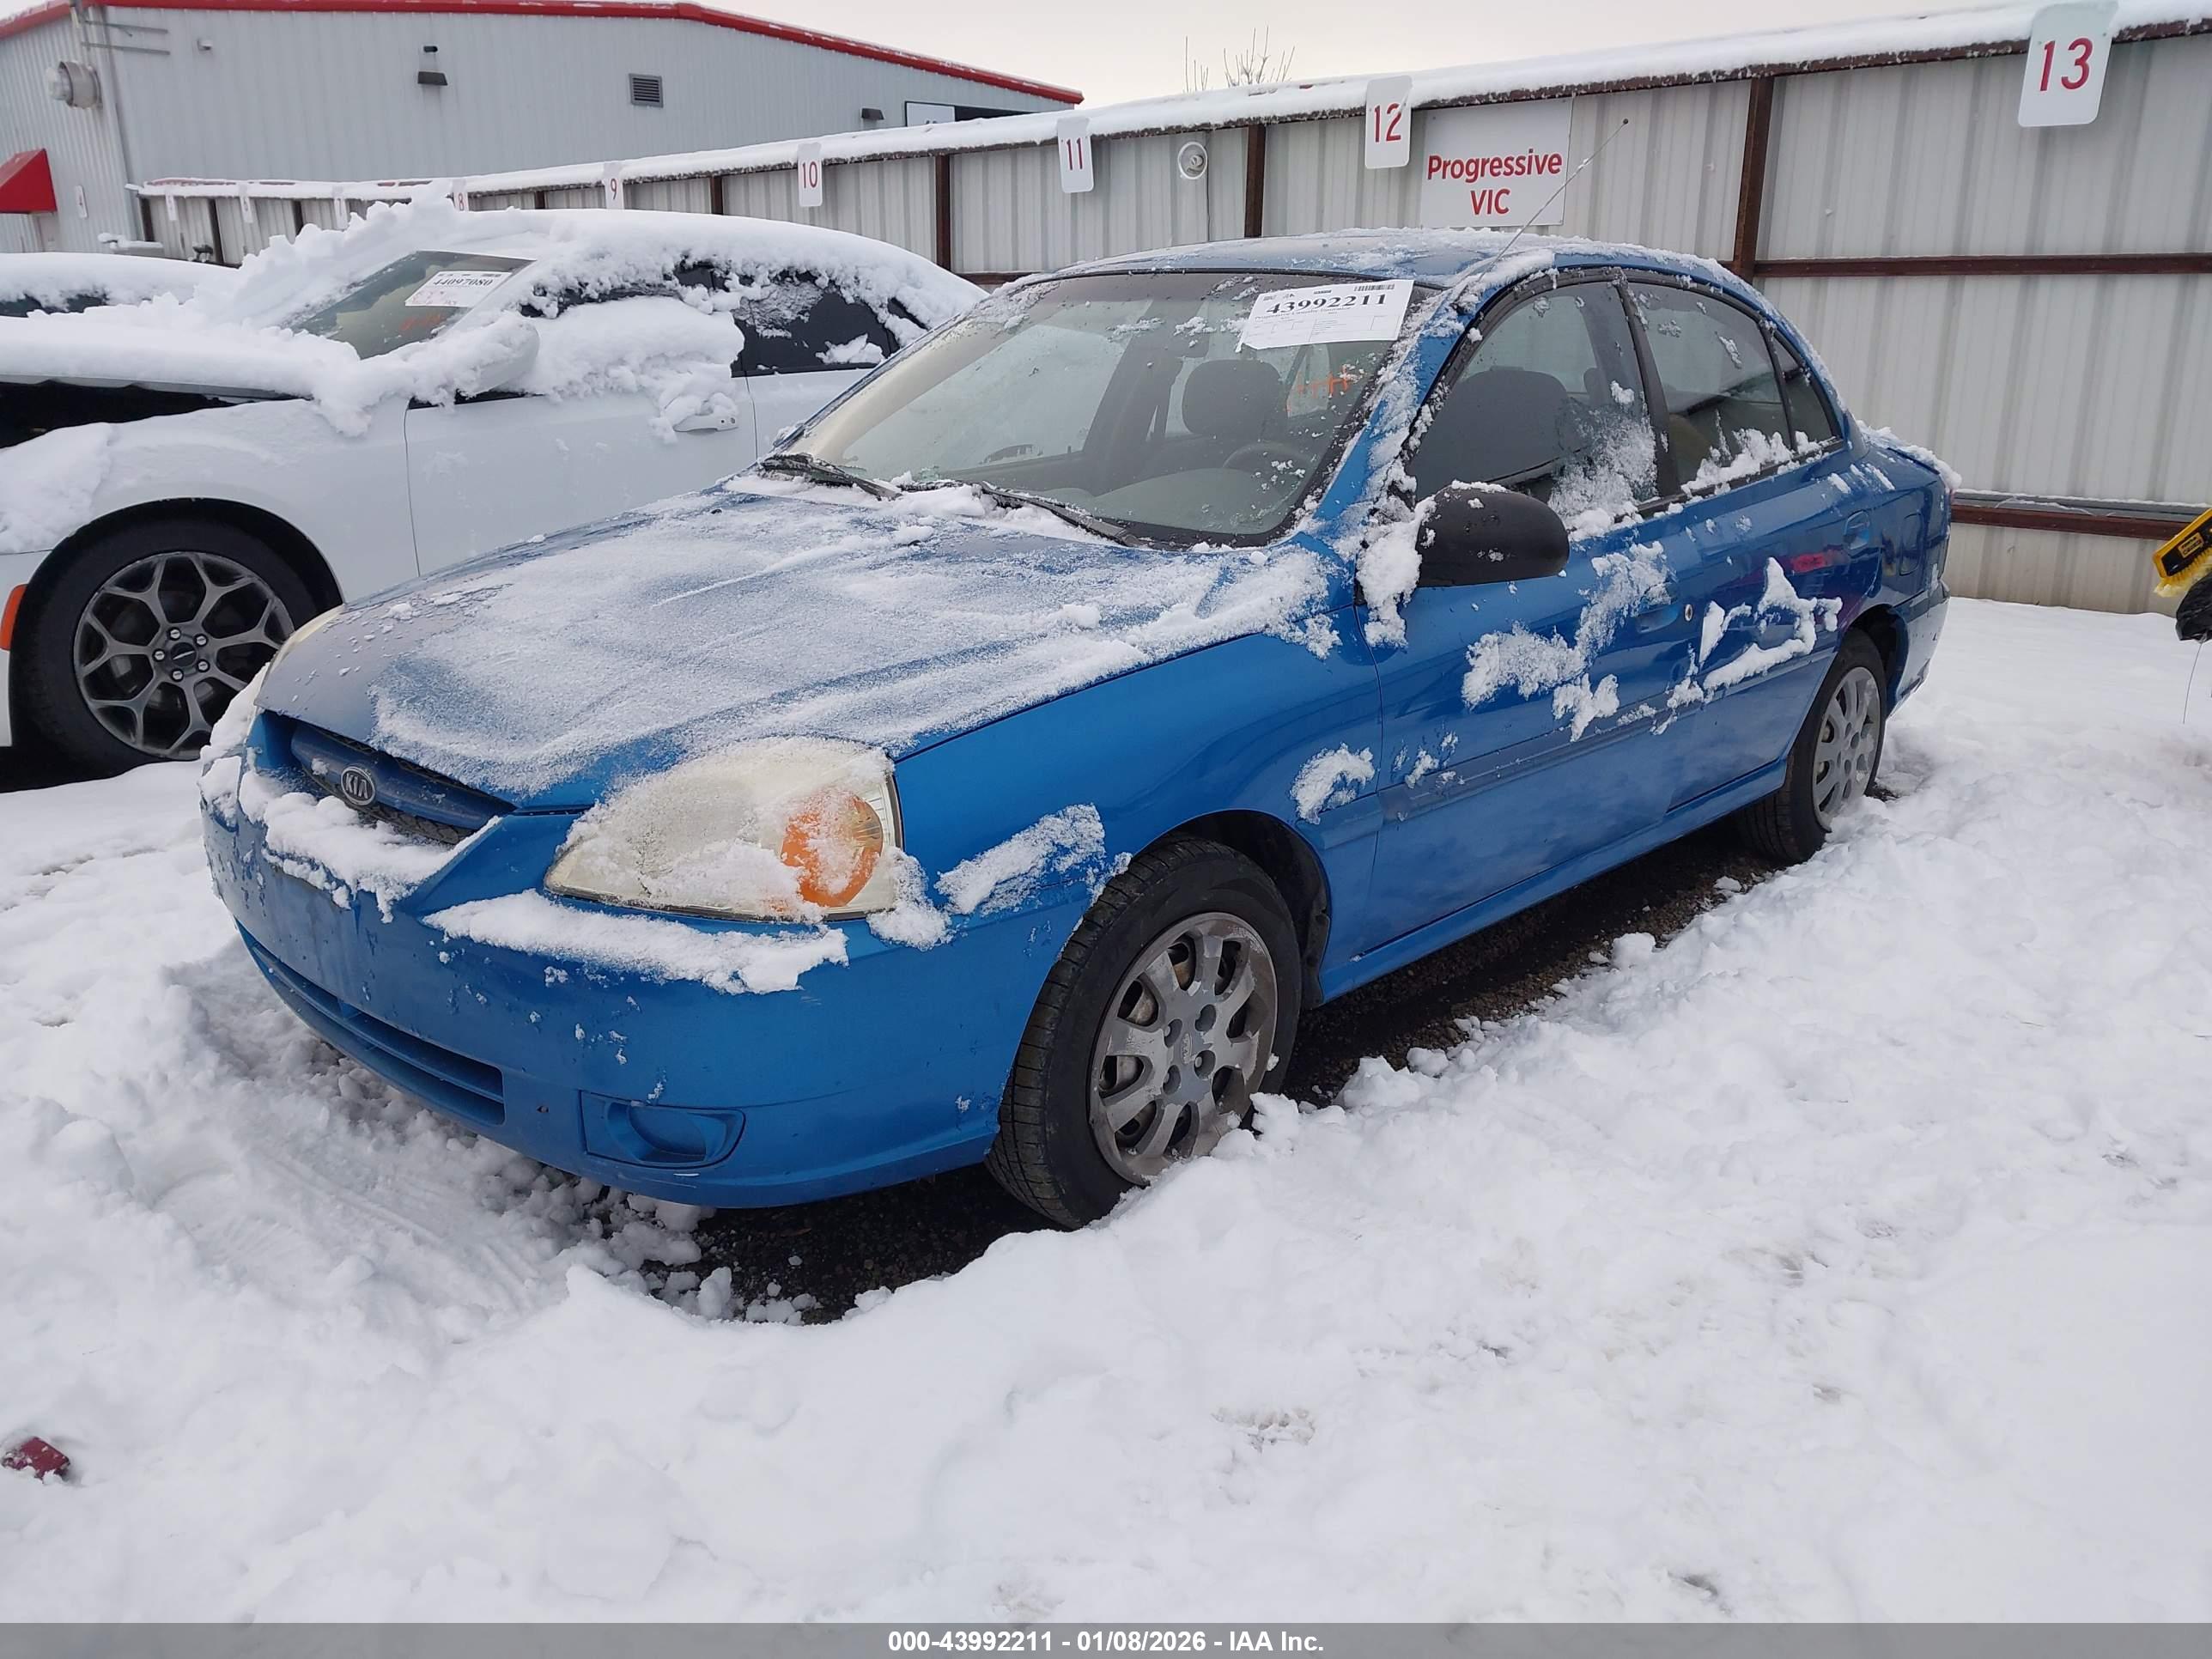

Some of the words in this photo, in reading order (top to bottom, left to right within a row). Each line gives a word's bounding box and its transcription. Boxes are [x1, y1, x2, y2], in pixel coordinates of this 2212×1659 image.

[2039, 37, 2094, 92] 13
[1374, 102, 1402, 143] 12
[1065, 137, 1084, 171] 11
[1427, 149, 1563, 184] Progressive
[610, 178, 617, 200] 9
[801, 161, 817, 189] 10
[458, 192, 465, 211] 8
[1470, 188, 1511, 216] VIC
[1267, 294, 1386, 314] 43992211
[346, 773, 368, 799] KIA
